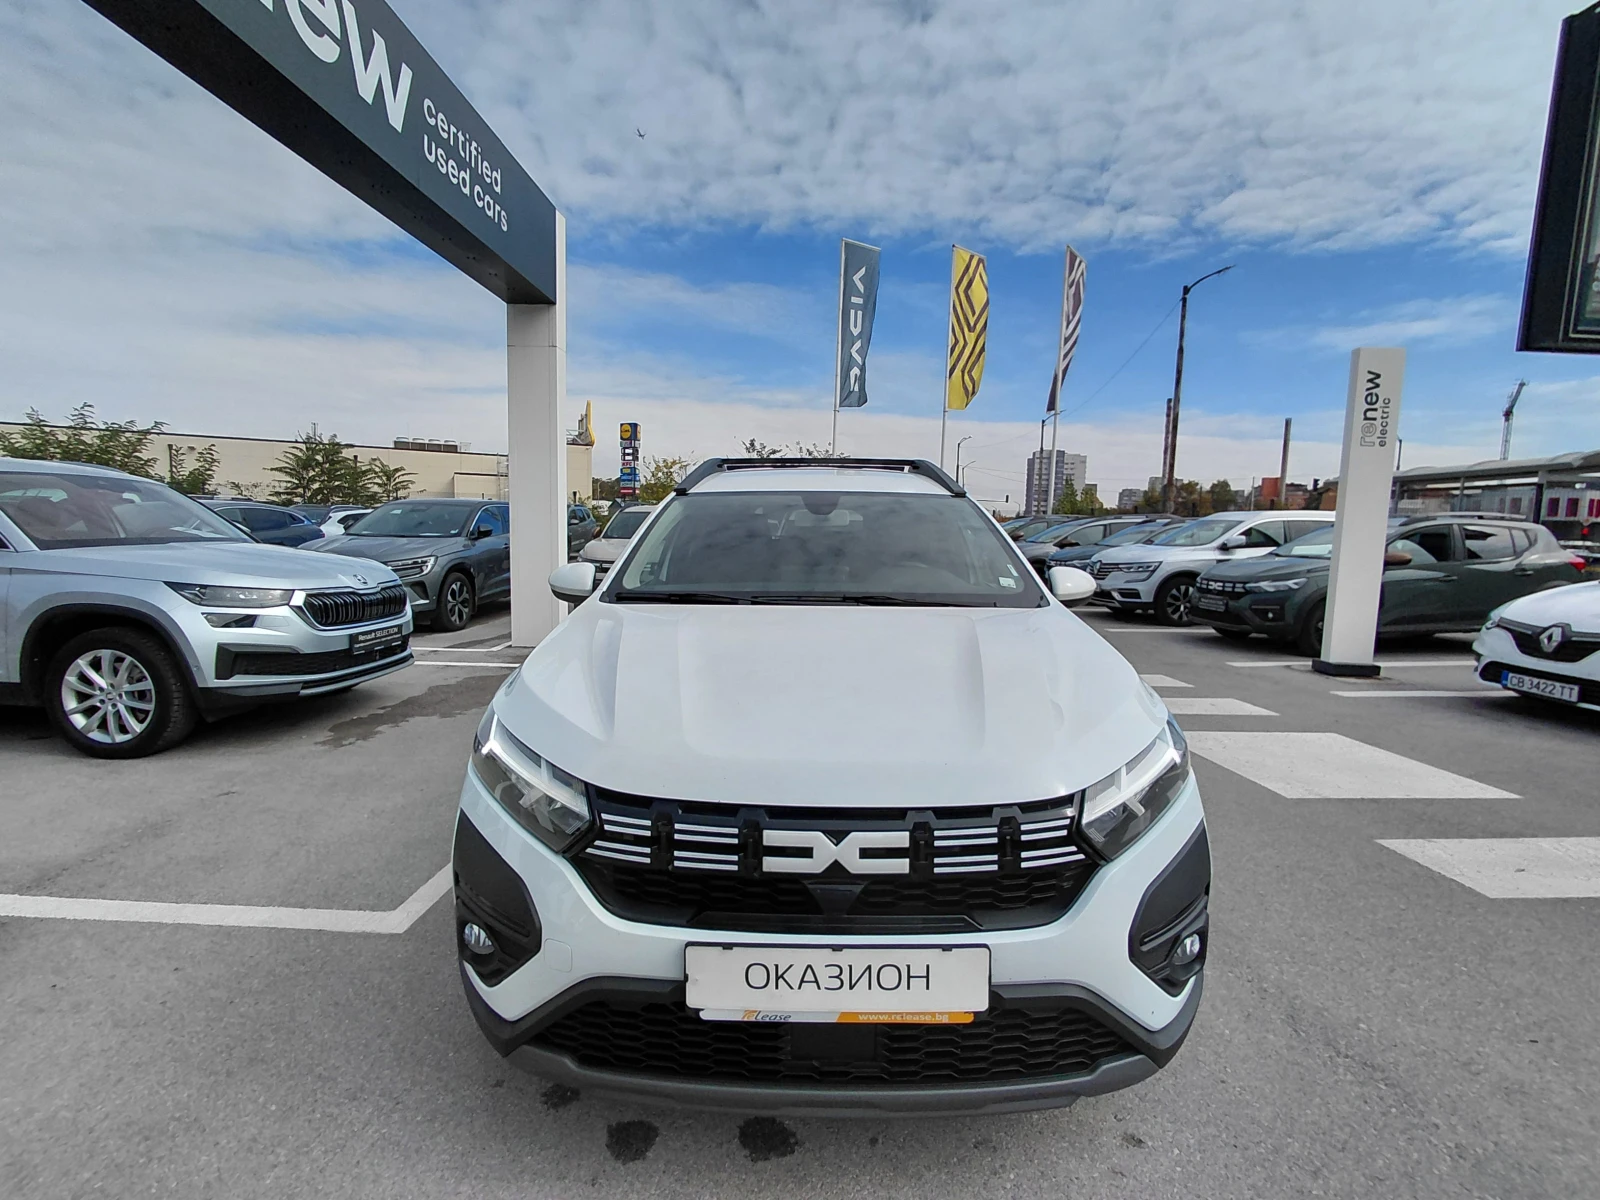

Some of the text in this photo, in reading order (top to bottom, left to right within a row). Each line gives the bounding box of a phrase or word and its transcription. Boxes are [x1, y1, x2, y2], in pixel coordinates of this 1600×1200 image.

[260, 0, 413, 134] ew
[423, 98, 501, 195] certified
[423, 133, 508, 232] used cars
[850, 265, 867, 392] DACIA
[1360, 370, 1382, 447] renew
[1376, 397, 1391, 447] electric
[358, 632, 376, 641] Renault
[375, 627, 399, 638] SELECTION
[1527, 679, 1557, 695] 3422
[744, 962, 931, 992] ОКАЗИОН
